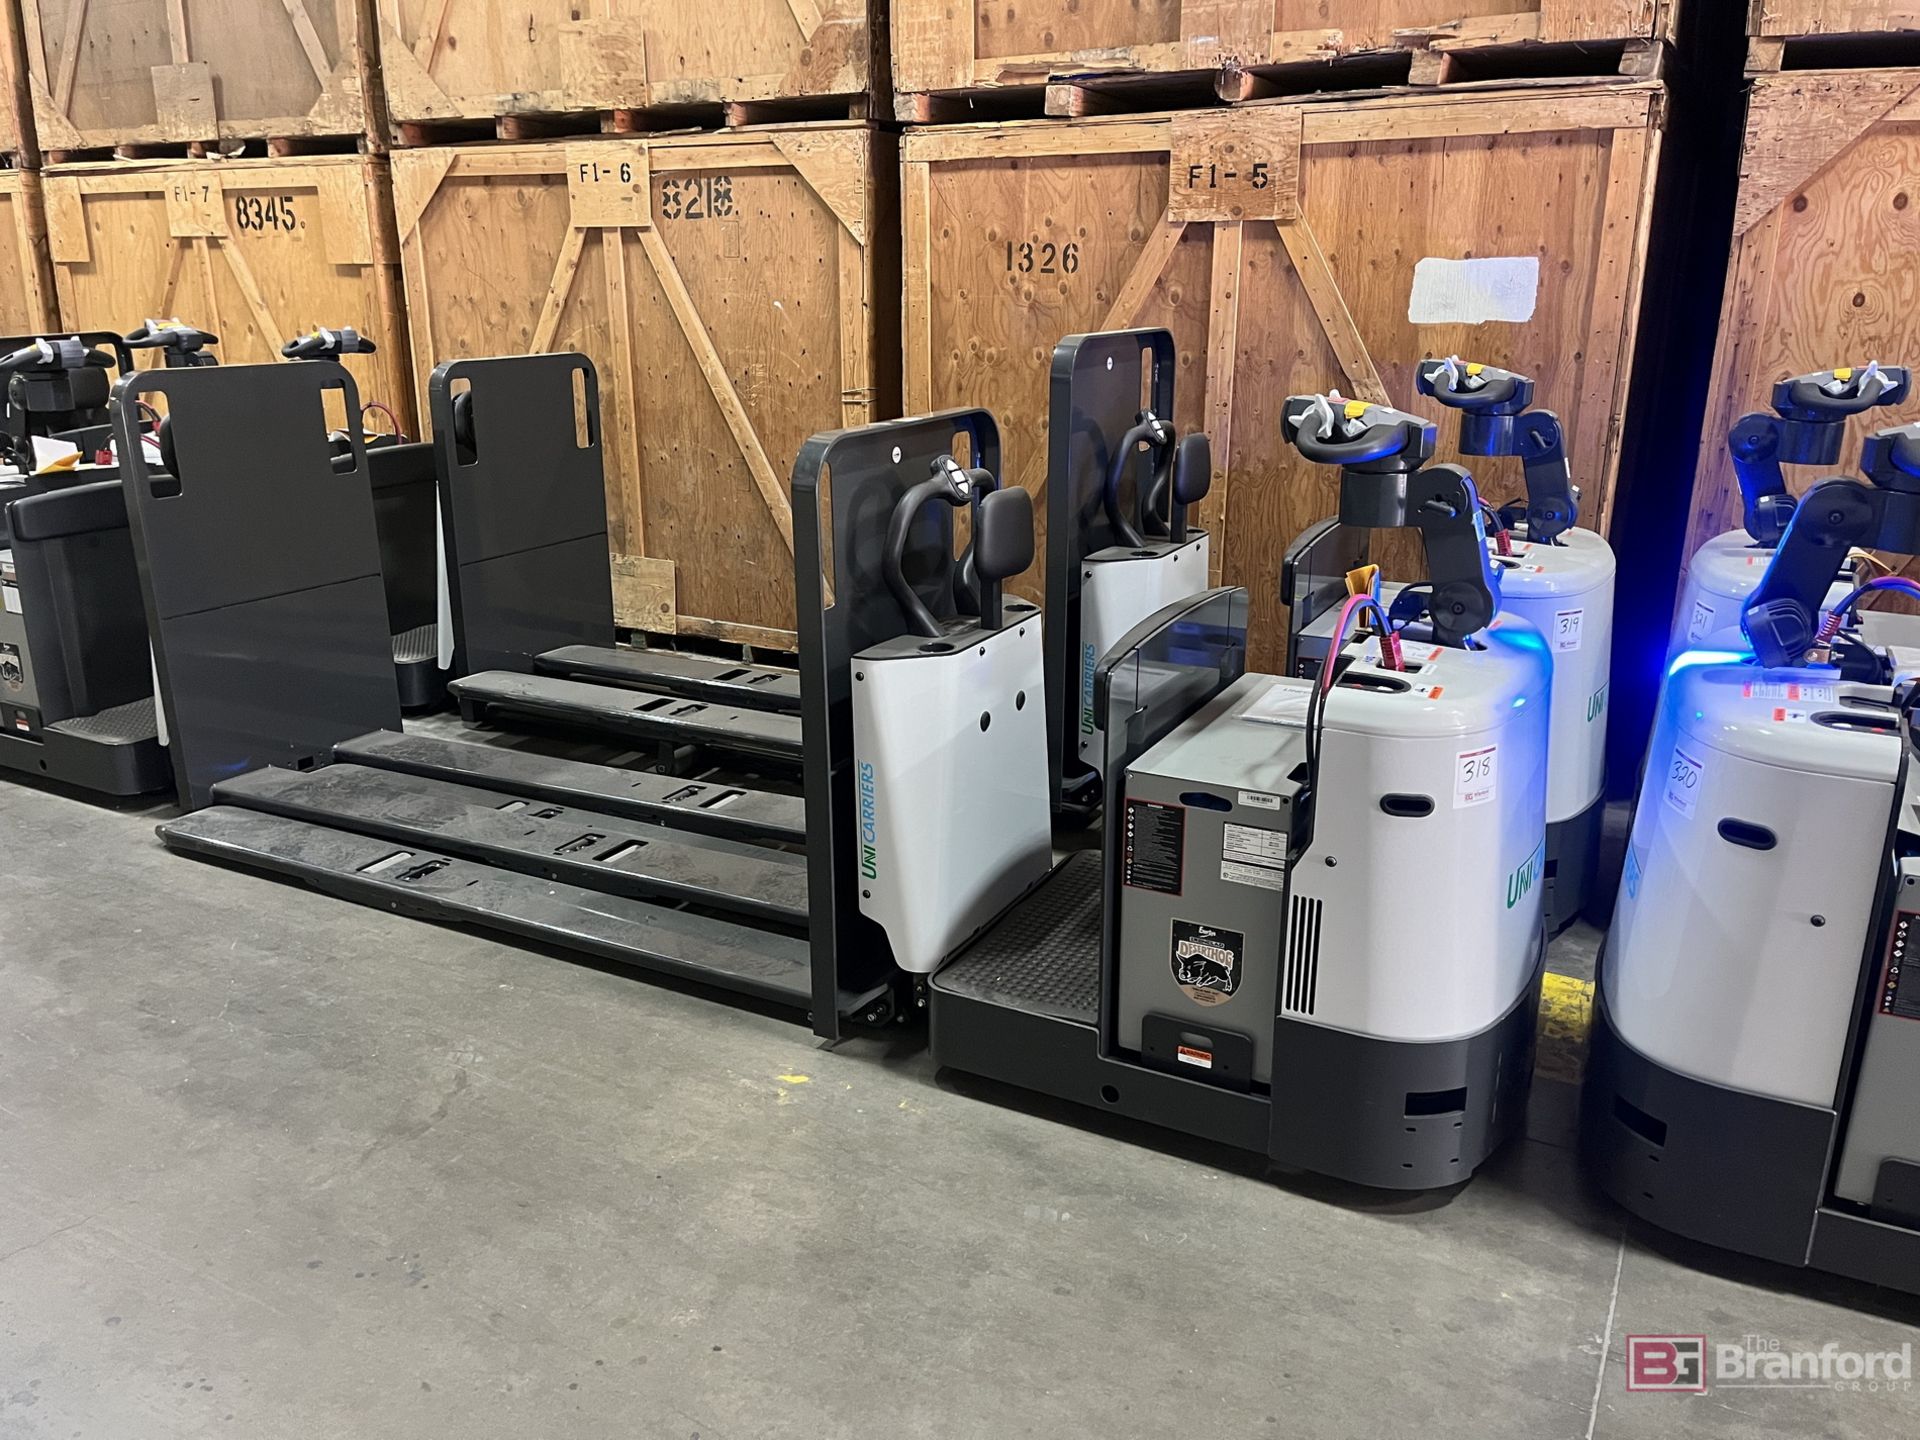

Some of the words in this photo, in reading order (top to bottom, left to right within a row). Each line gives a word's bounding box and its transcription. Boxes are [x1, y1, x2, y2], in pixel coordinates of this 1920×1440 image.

[236, 195, 296, 231] 8345
[1006, 241, 1079, 274] 1326
[1560, 617, 1580, 634] 319
[1464, 756, 1491, 783] 318
[1671, 760, 1698, 789] 320
